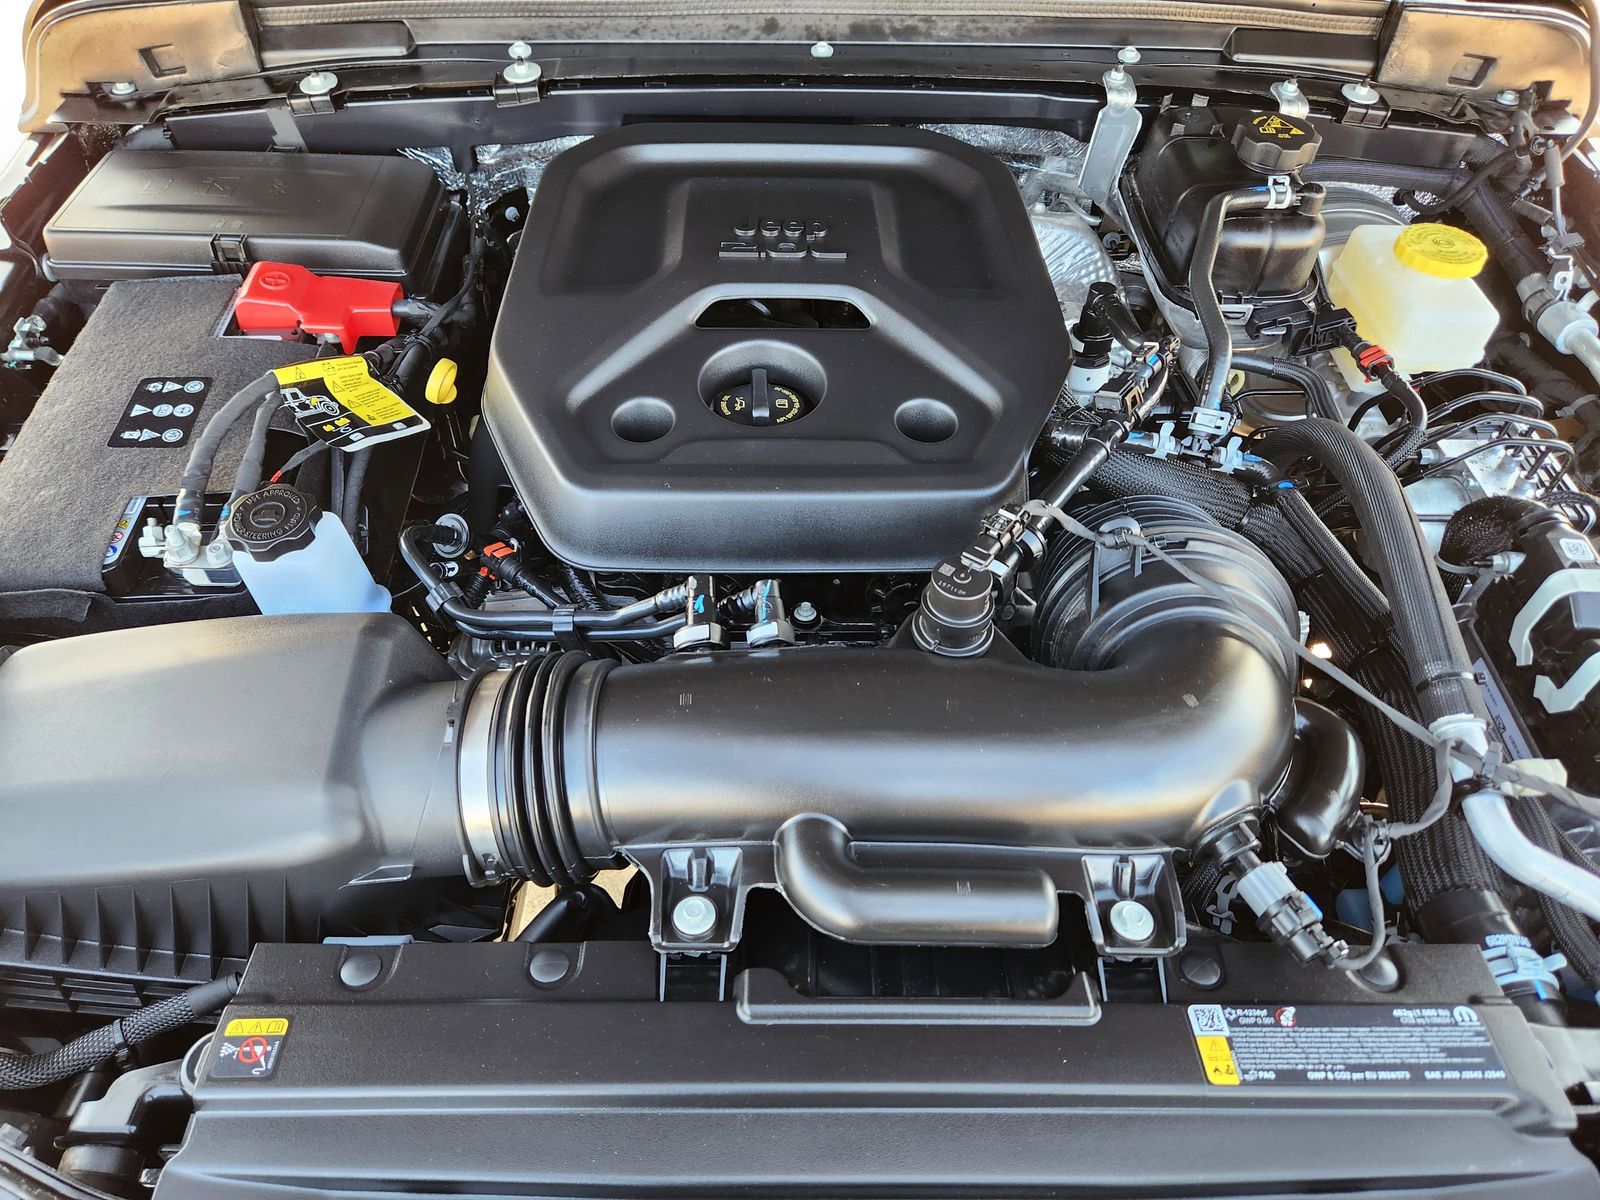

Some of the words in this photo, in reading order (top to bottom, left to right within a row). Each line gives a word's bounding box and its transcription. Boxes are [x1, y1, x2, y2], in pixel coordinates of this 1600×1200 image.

[733, 219, 828, 241] Jeep
[718, 241, 848, 259] 2.0L
[246, 494, 261, 505] USE
[263, 489, 301, 505] APPROVED
[284, 512, 301, 531] FLUID
[1258, 1071, 1276, 1080] PAG
